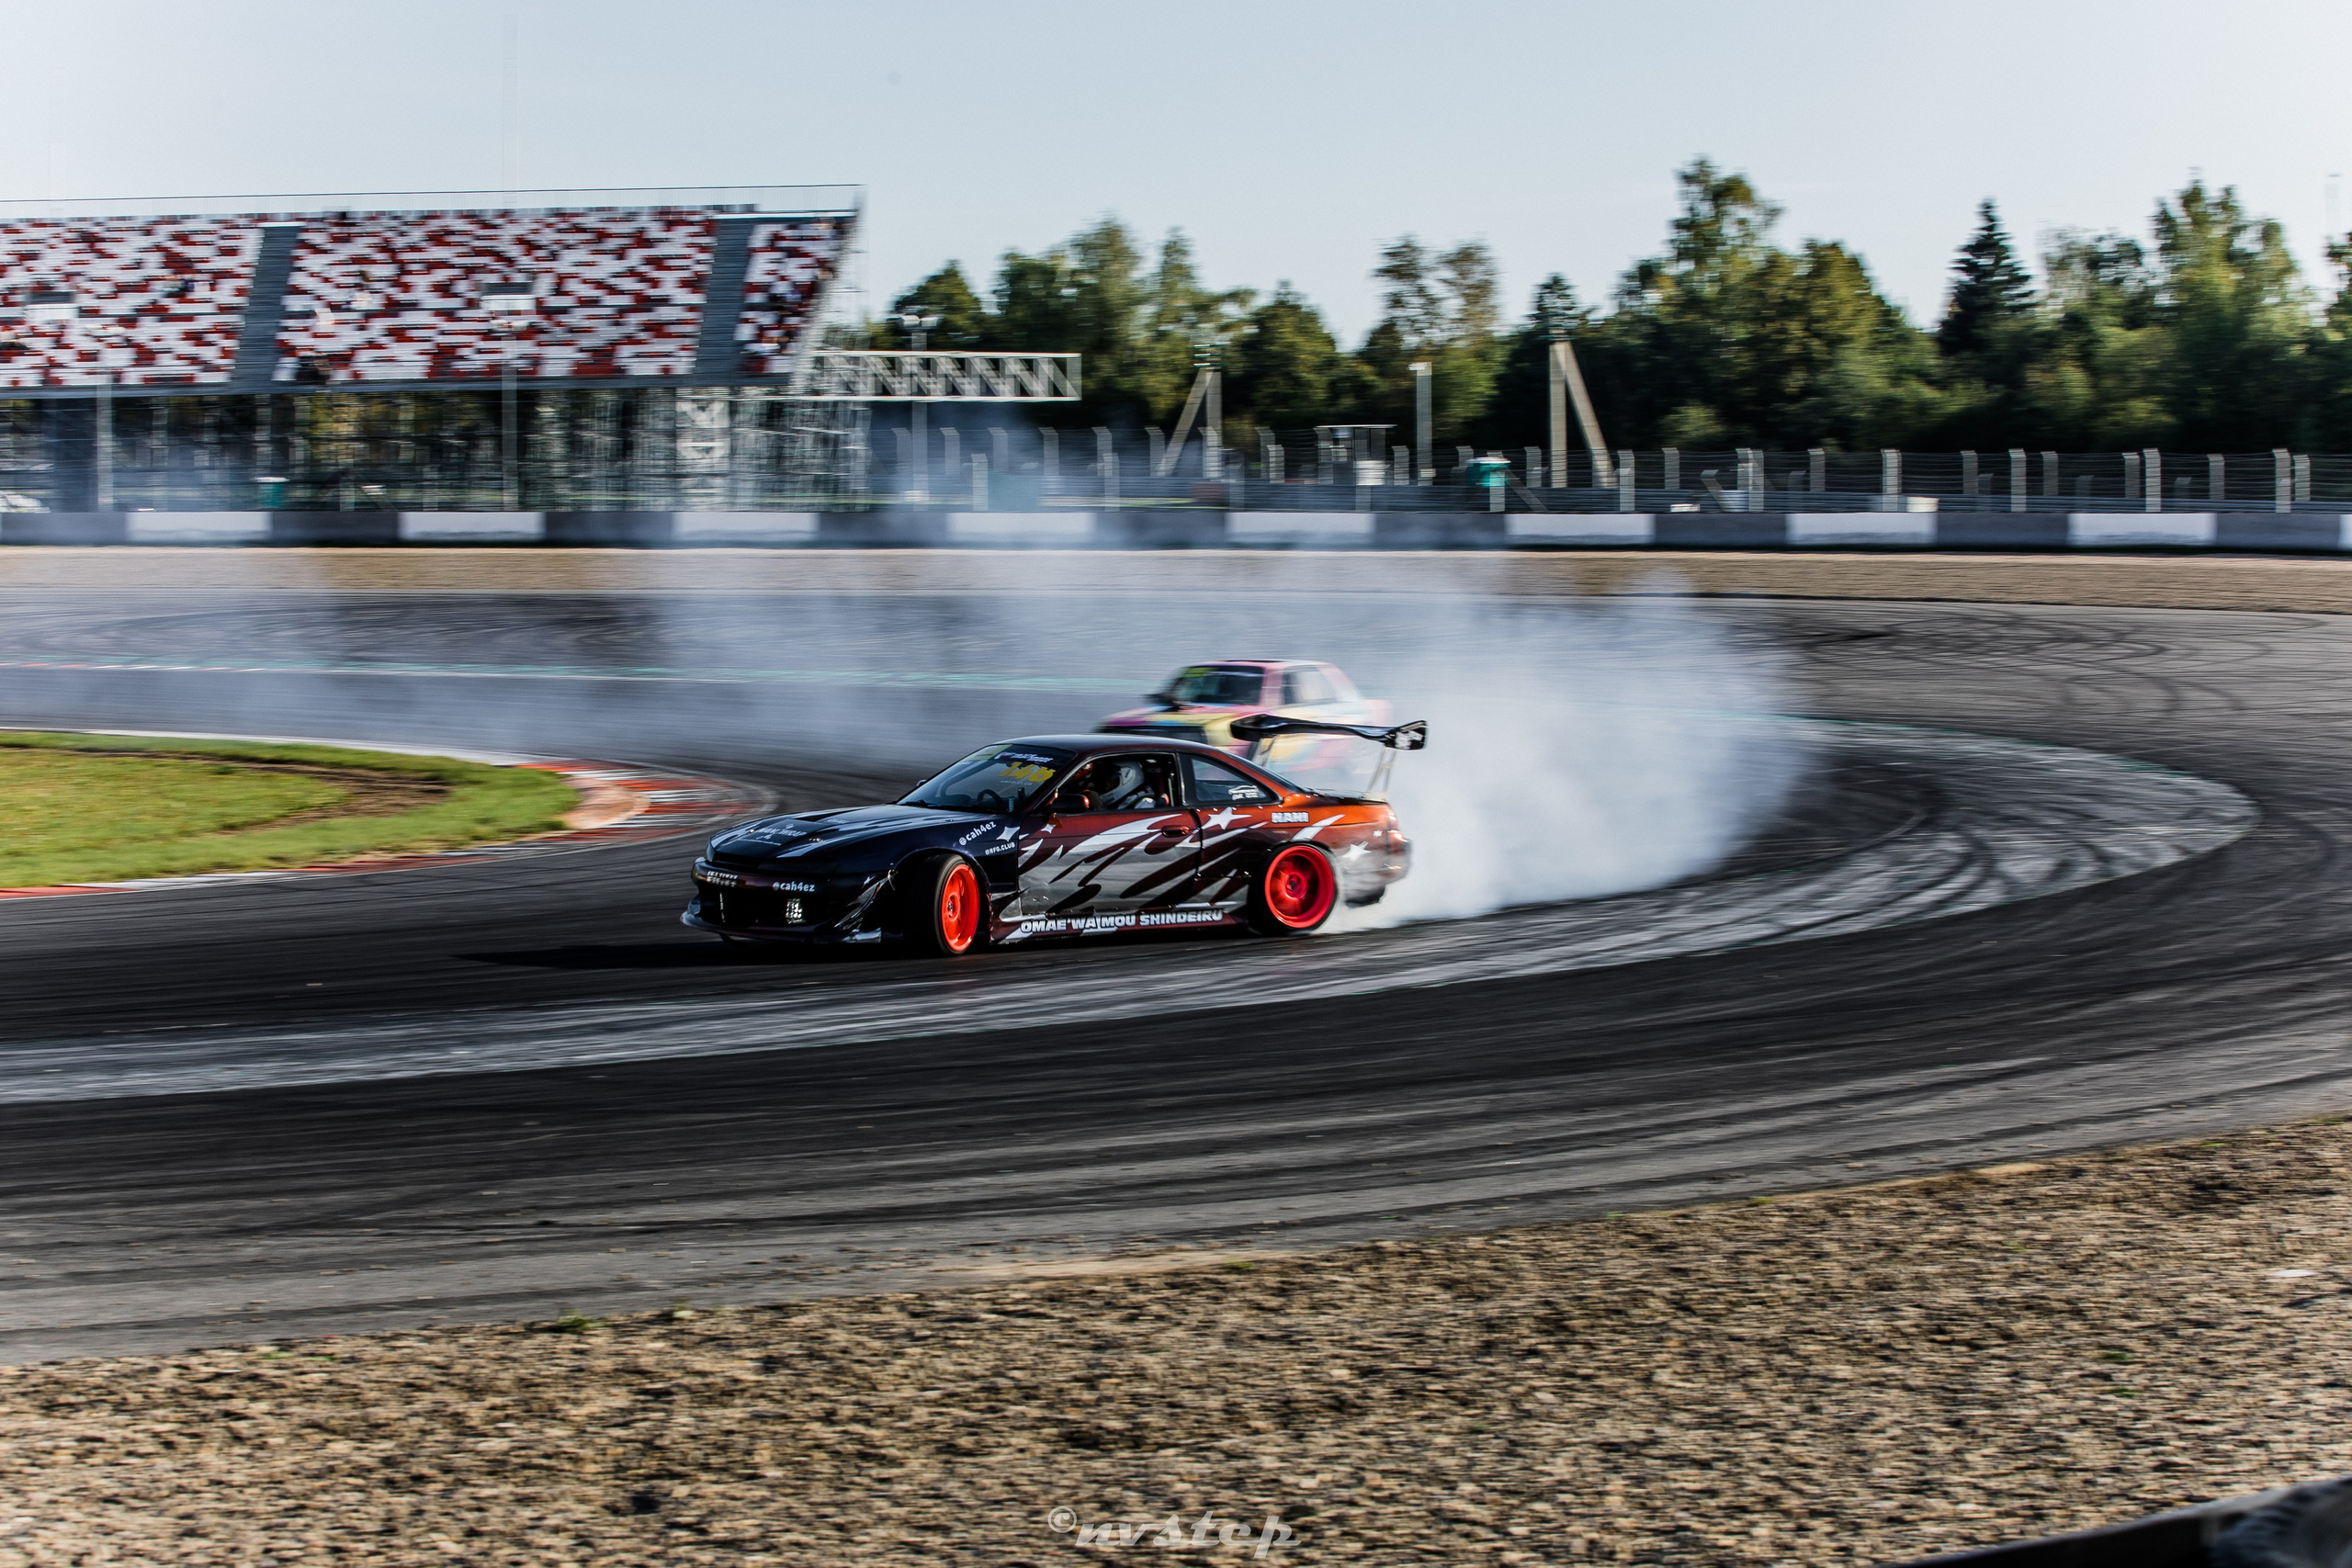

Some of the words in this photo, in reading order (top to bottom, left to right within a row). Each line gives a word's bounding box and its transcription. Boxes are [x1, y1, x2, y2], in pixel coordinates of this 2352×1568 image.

[958, 820, 997, 846] @cah4ez
[772, 881, 816, 893] @cah4ez
[1101, 912, 1136, 928] MOU
[1139, 908, 1223, 926] SHINDEIRU
